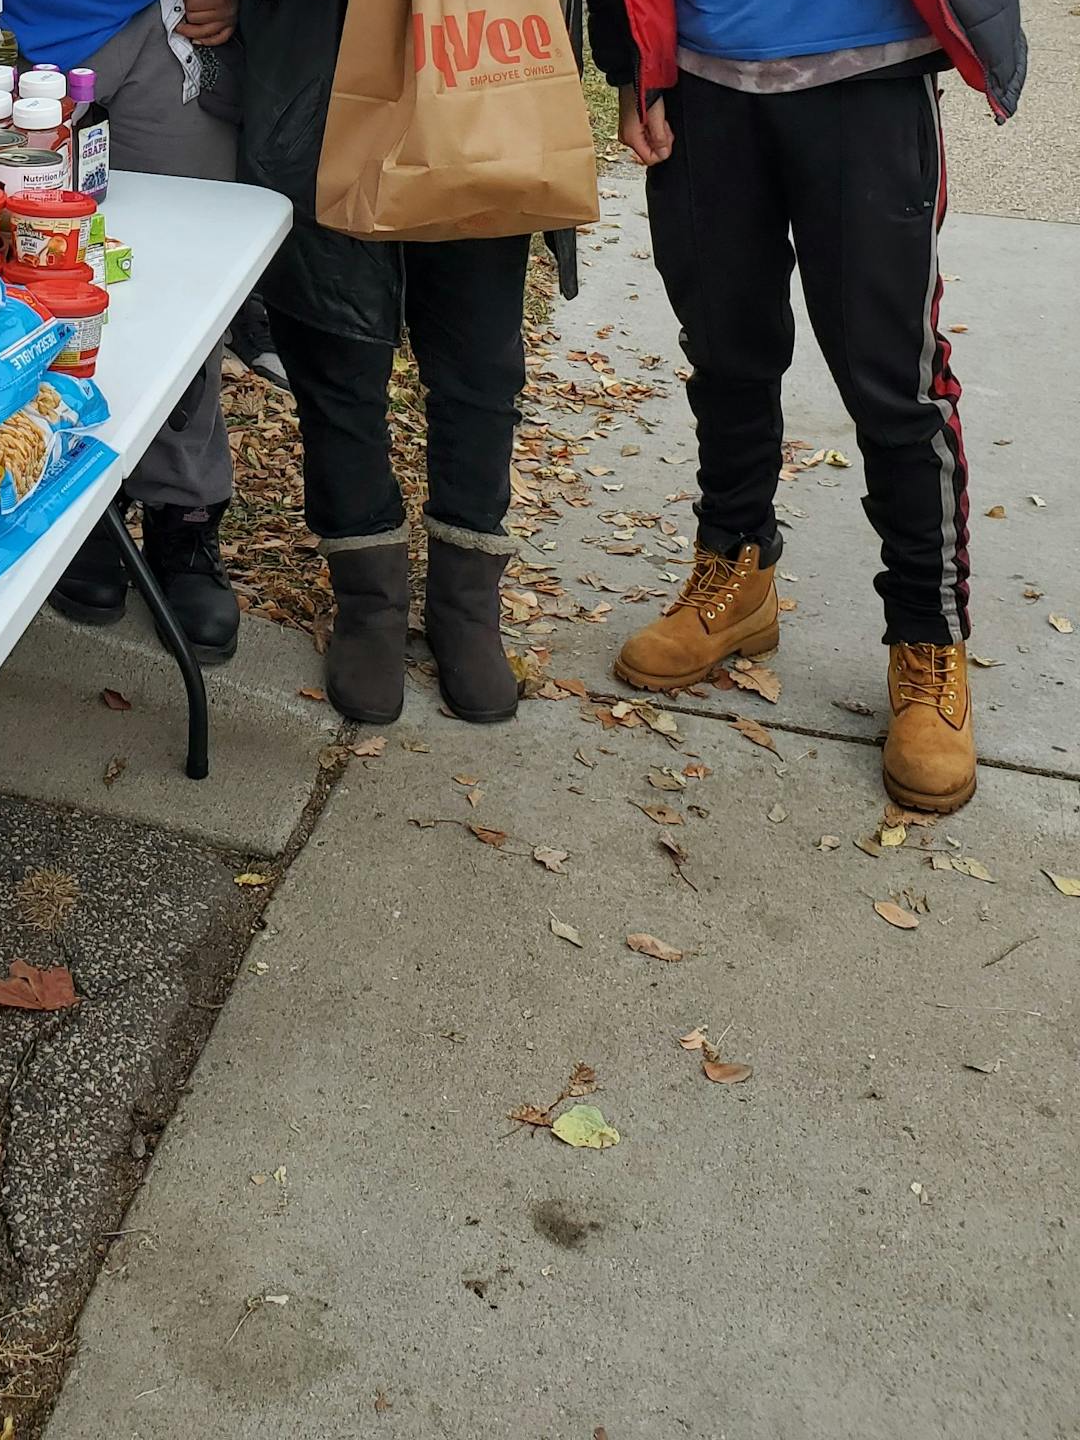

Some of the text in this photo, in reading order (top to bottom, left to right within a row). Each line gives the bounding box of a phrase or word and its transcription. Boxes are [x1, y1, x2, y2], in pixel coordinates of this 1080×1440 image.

[470, 65, 555, 87] EMPLOYEE OWNED
[23, 173, 58, 183] Nutrition
[10, 329, 57, 371] RESEALABLE
